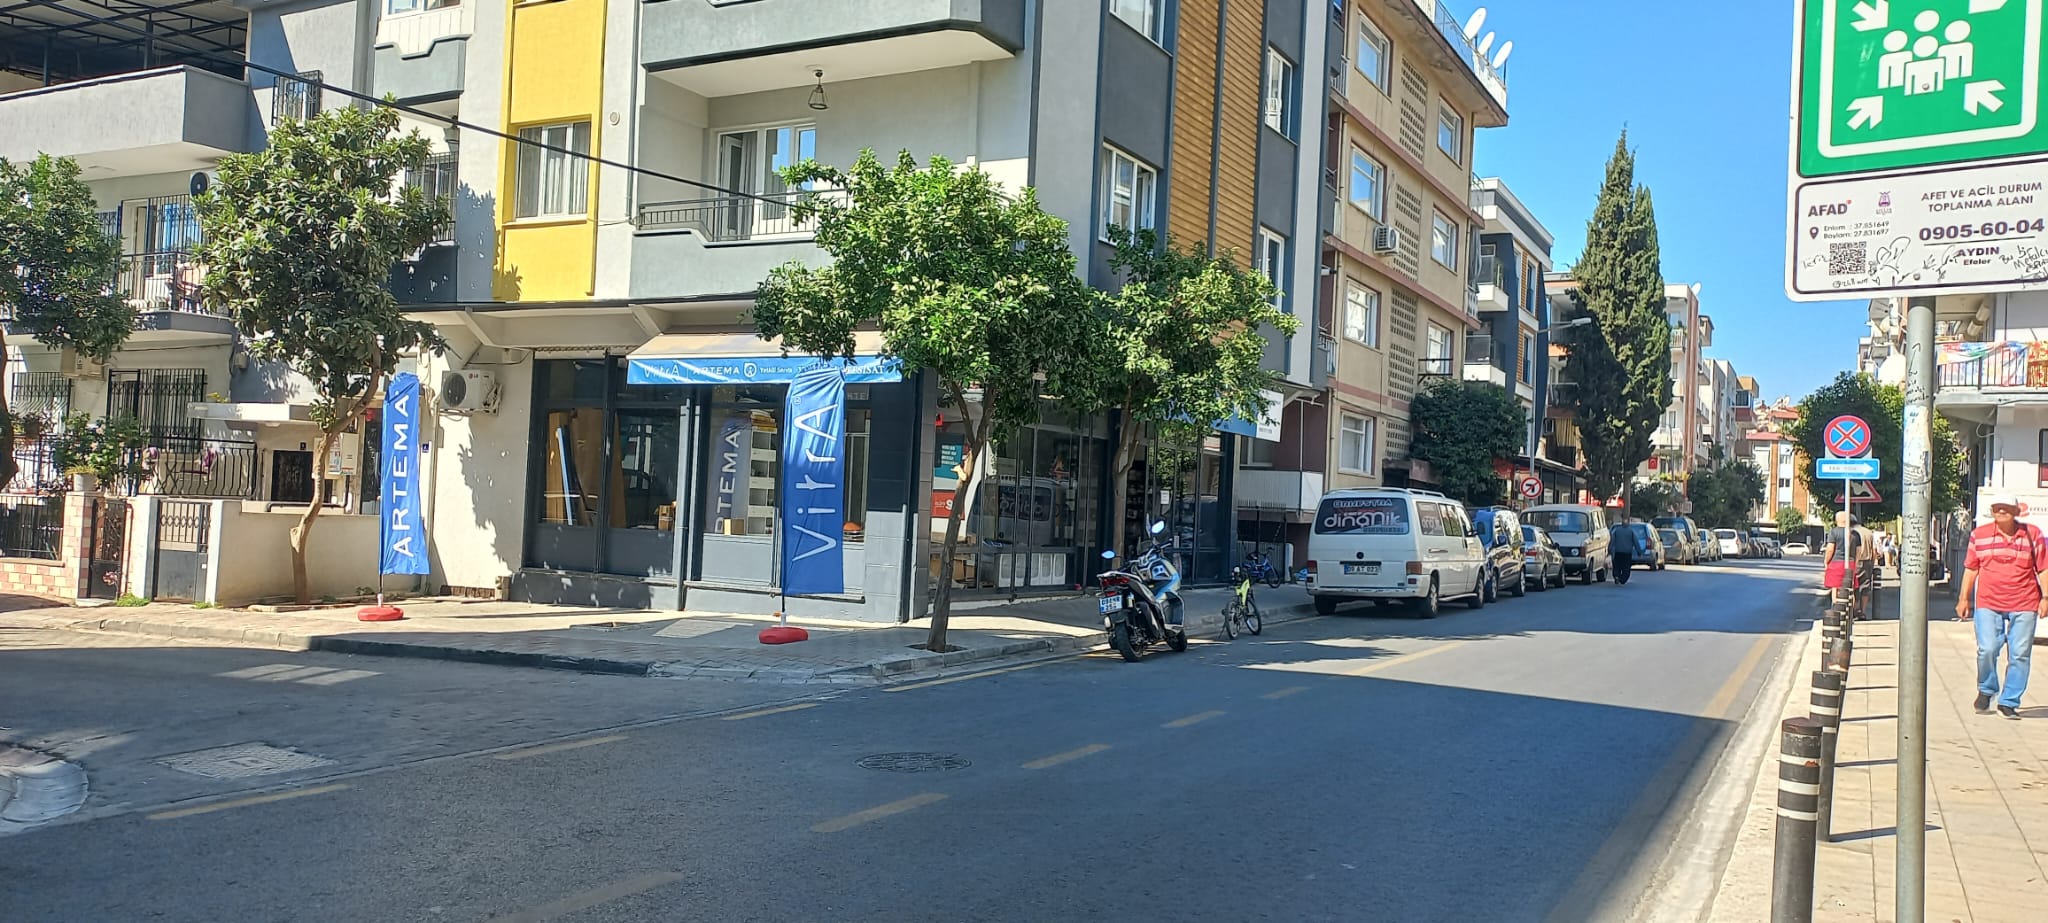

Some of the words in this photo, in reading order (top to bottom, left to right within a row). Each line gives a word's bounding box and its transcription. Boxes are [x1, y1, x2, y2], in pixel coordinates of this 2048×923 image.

[1921, 190, 1947, 201] AFET
[1950, 189, 1966, 199] VE
[1968, 184, 1996, 197] ACİL
[1999, 181, 2043, 194] DURUM
[1808, 203, 1848, 217] AFAD
[1928, 200, 1993, 212] TOPLANMA
[1996, 195, 2034, 207] ALANI
[1919, 218, 2045, 241] 0905-60-04
[1956, 246, 2000, 257] AYDIN
[1963, 258, 1991, 266] Efeler
[693, 366, 740, 376] ARTEMA
[392, 394, 415, 558] ARTEMA
[714, 430, 742, 534] RTEMA
[791, 403, 839, 562] VitrA
